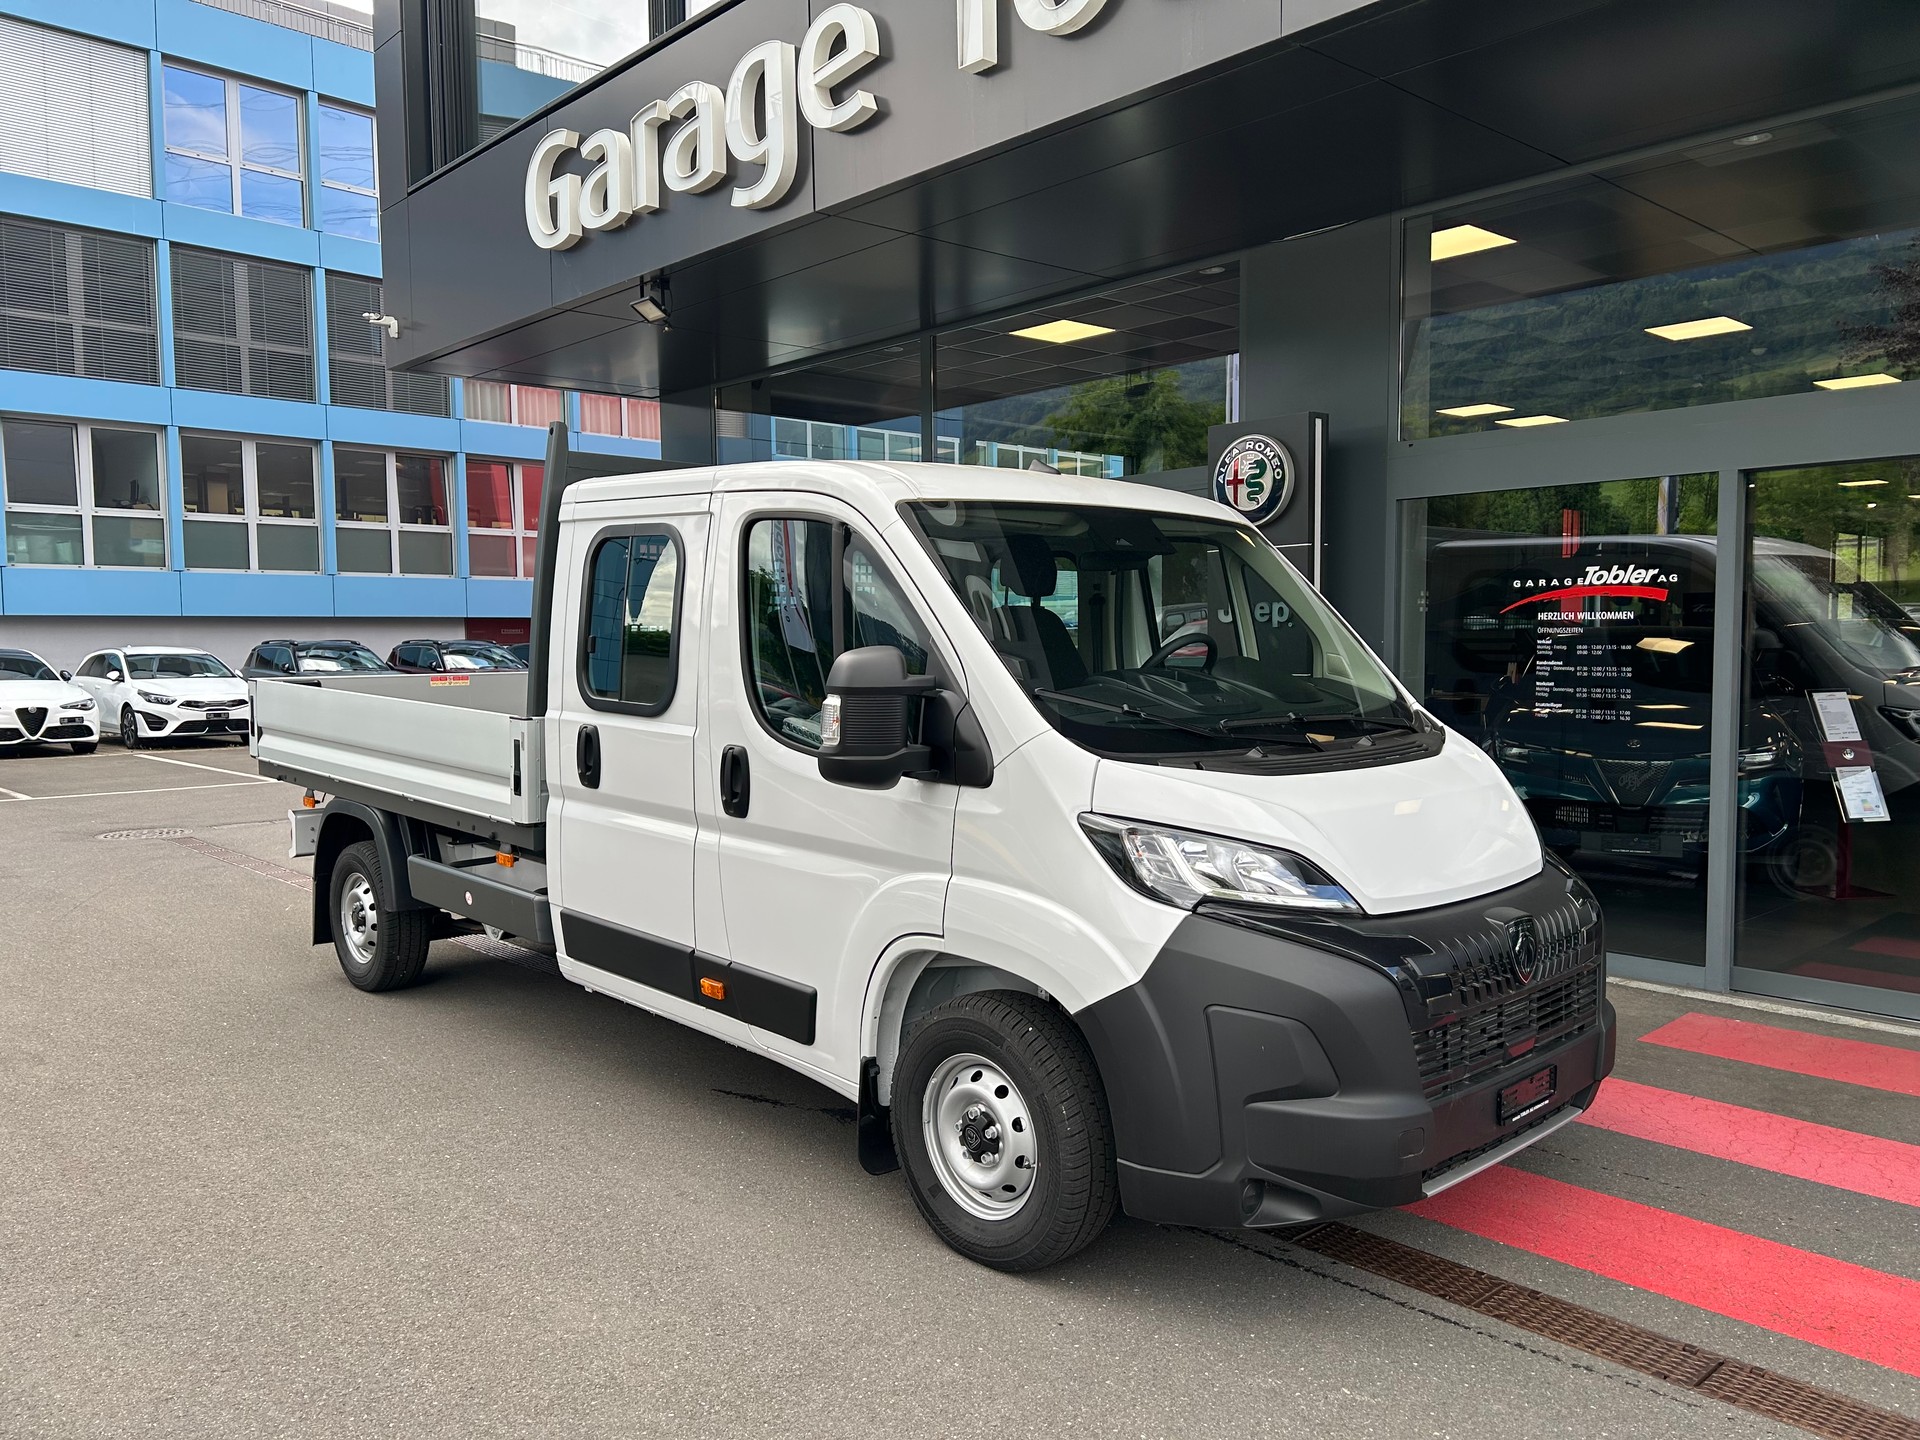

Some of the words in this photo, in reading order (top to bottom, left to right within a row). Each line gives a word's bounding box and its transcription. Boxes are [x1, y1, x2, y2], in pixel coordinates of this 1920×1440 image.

[525, 3, 879, 252] Garage
[1217, 447, 1240, 484] ALFA
[1245, 440, 1283, 480] ROMEO
[1513, 578, 1584, 588] GARAGE
[1583, 564, 1659, 585] Tobler
[1657, 574, 1678, 583] AG
[1218, 601, 1290, 628] Jep
[1537, 612, 1575, 621] HERZLICH
[1577, 611, 1634, 620] WILLKOMMEN
